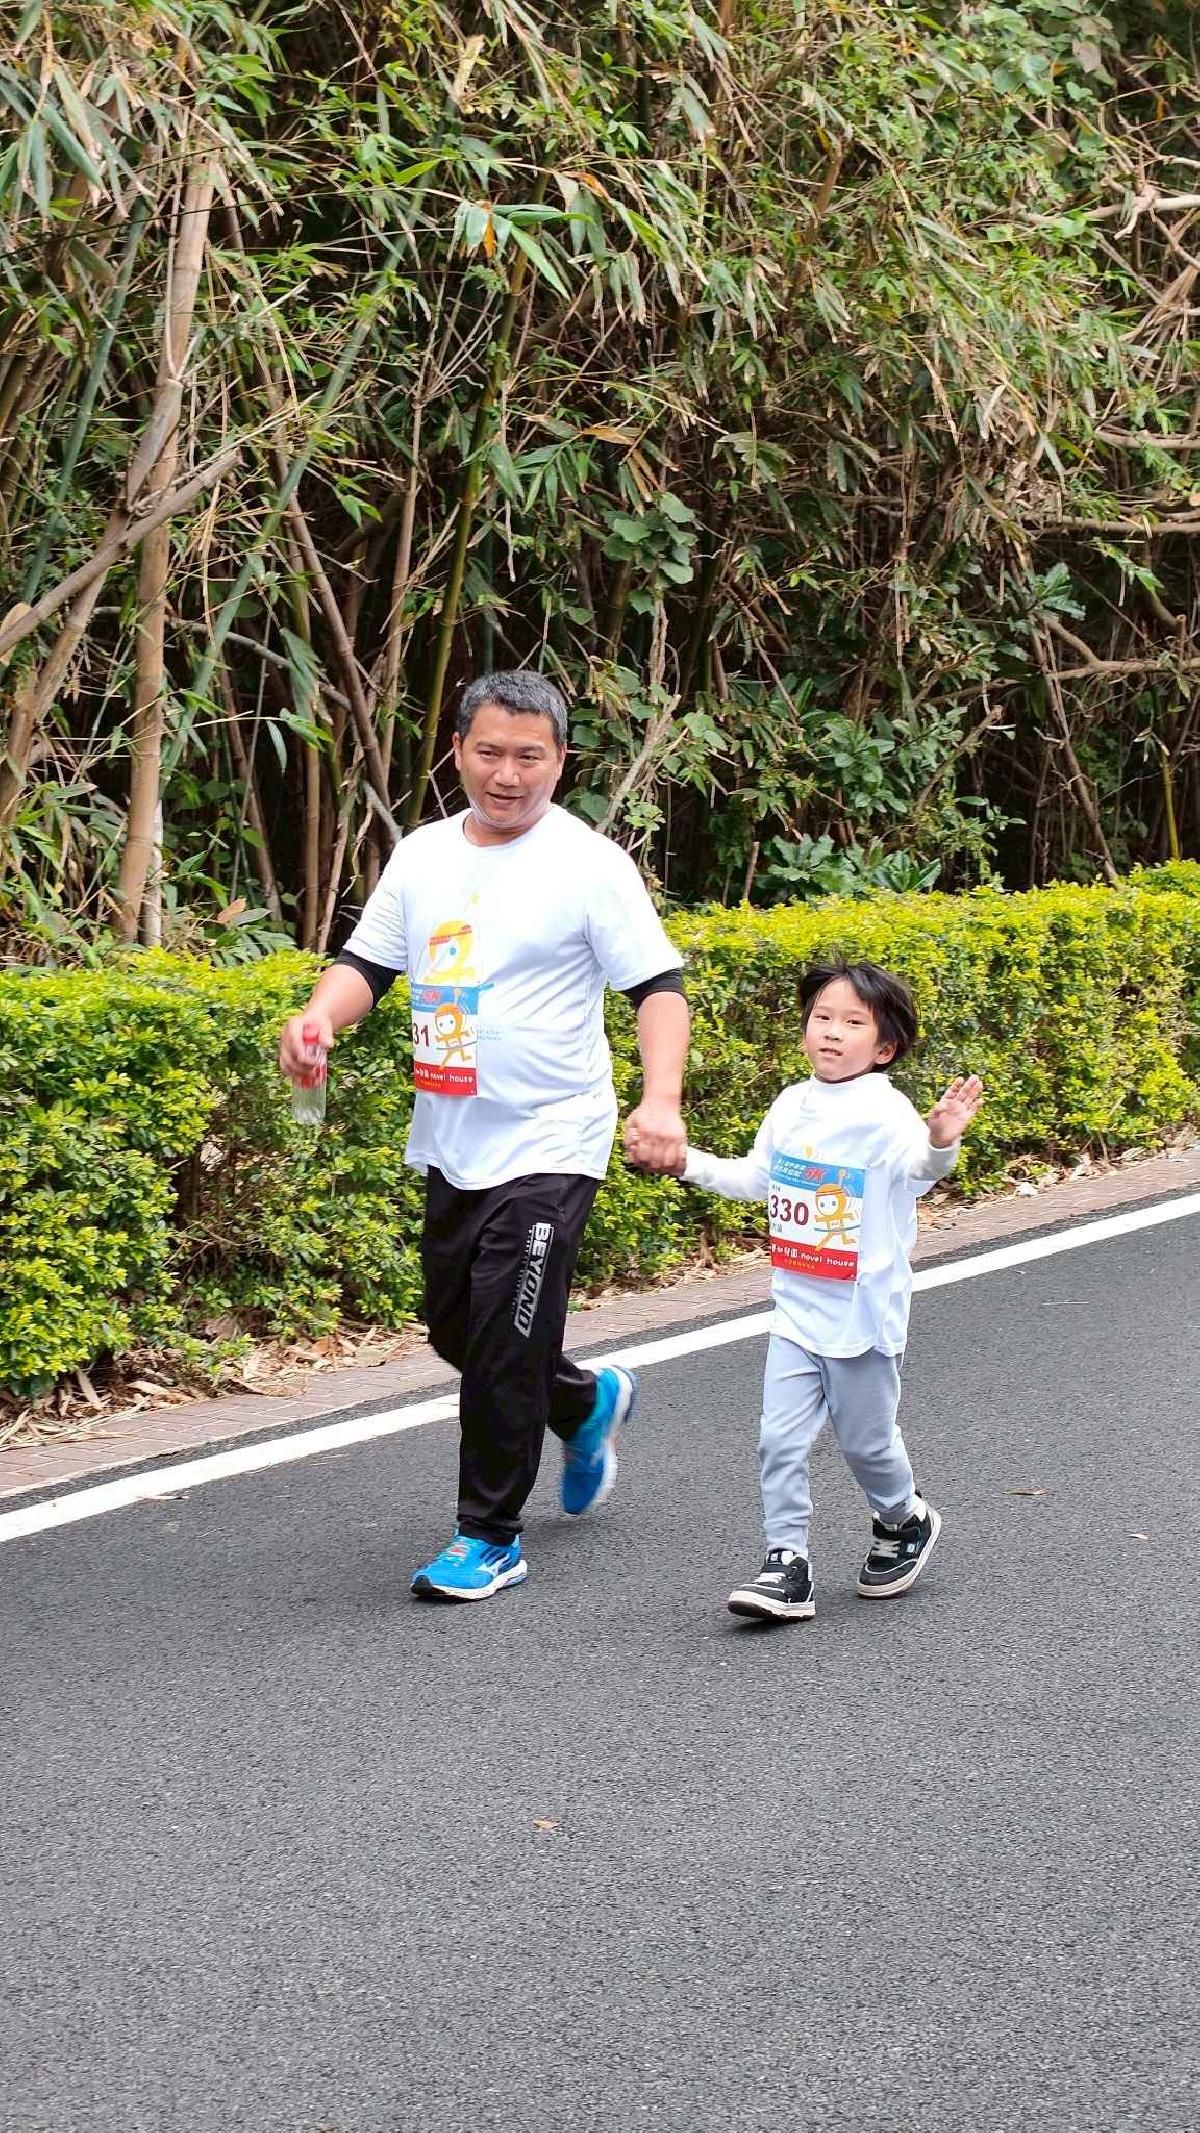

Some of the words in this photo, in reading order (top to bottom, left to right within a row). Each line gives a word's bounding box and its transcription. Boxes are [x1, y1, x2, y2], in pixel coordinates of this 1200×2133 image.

[770, 1195, 809, 1226] 330
[800, 1253, 822, 1263] novel
[826, 1258, 855, 1267] house
[514, 1222, 552, 1334] BEYOND
